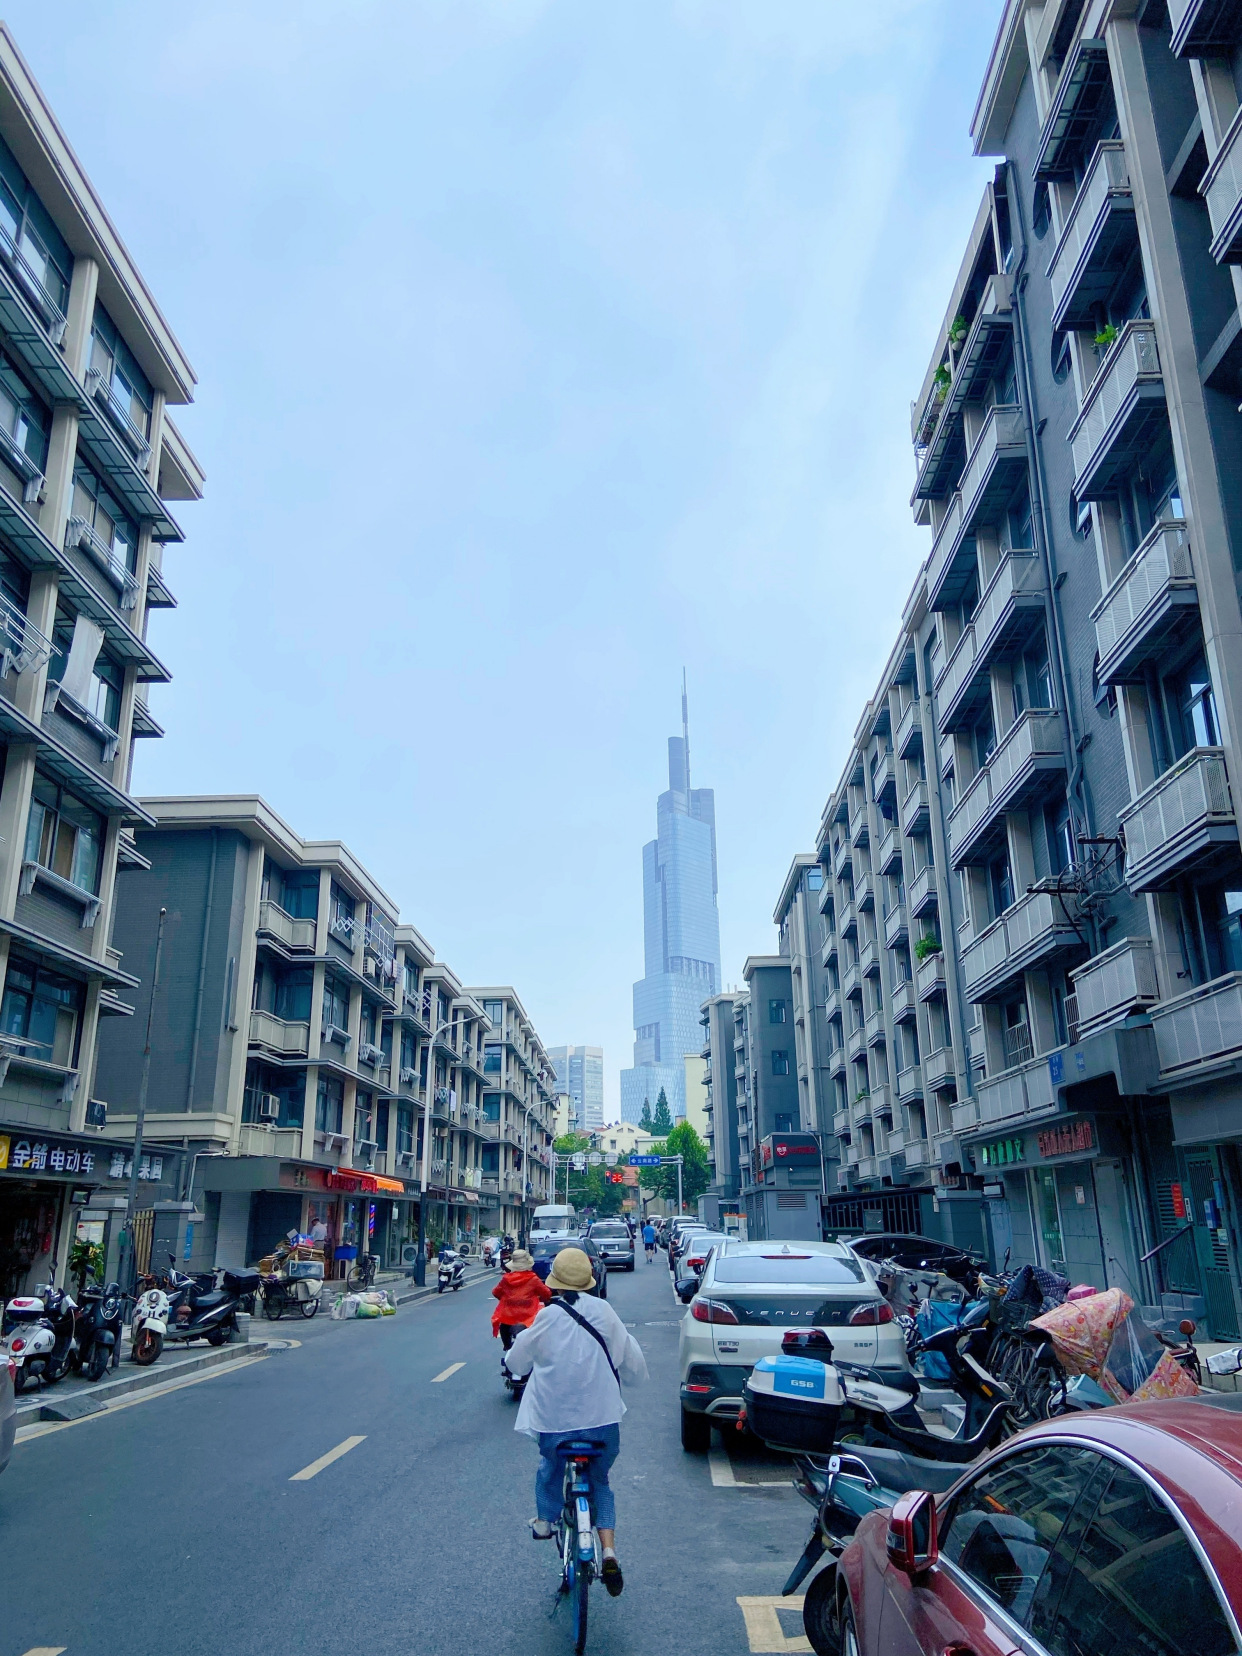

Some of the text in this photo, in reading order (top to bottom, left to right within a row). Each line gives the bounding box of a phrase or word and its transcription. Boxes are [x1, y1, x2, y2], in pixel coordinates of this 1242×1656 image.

[12, 1141, 95, 1173] 金箭电动车
[611, 1174, 623, 1183] 25
[790, 1379, 815, 1389] GSB
